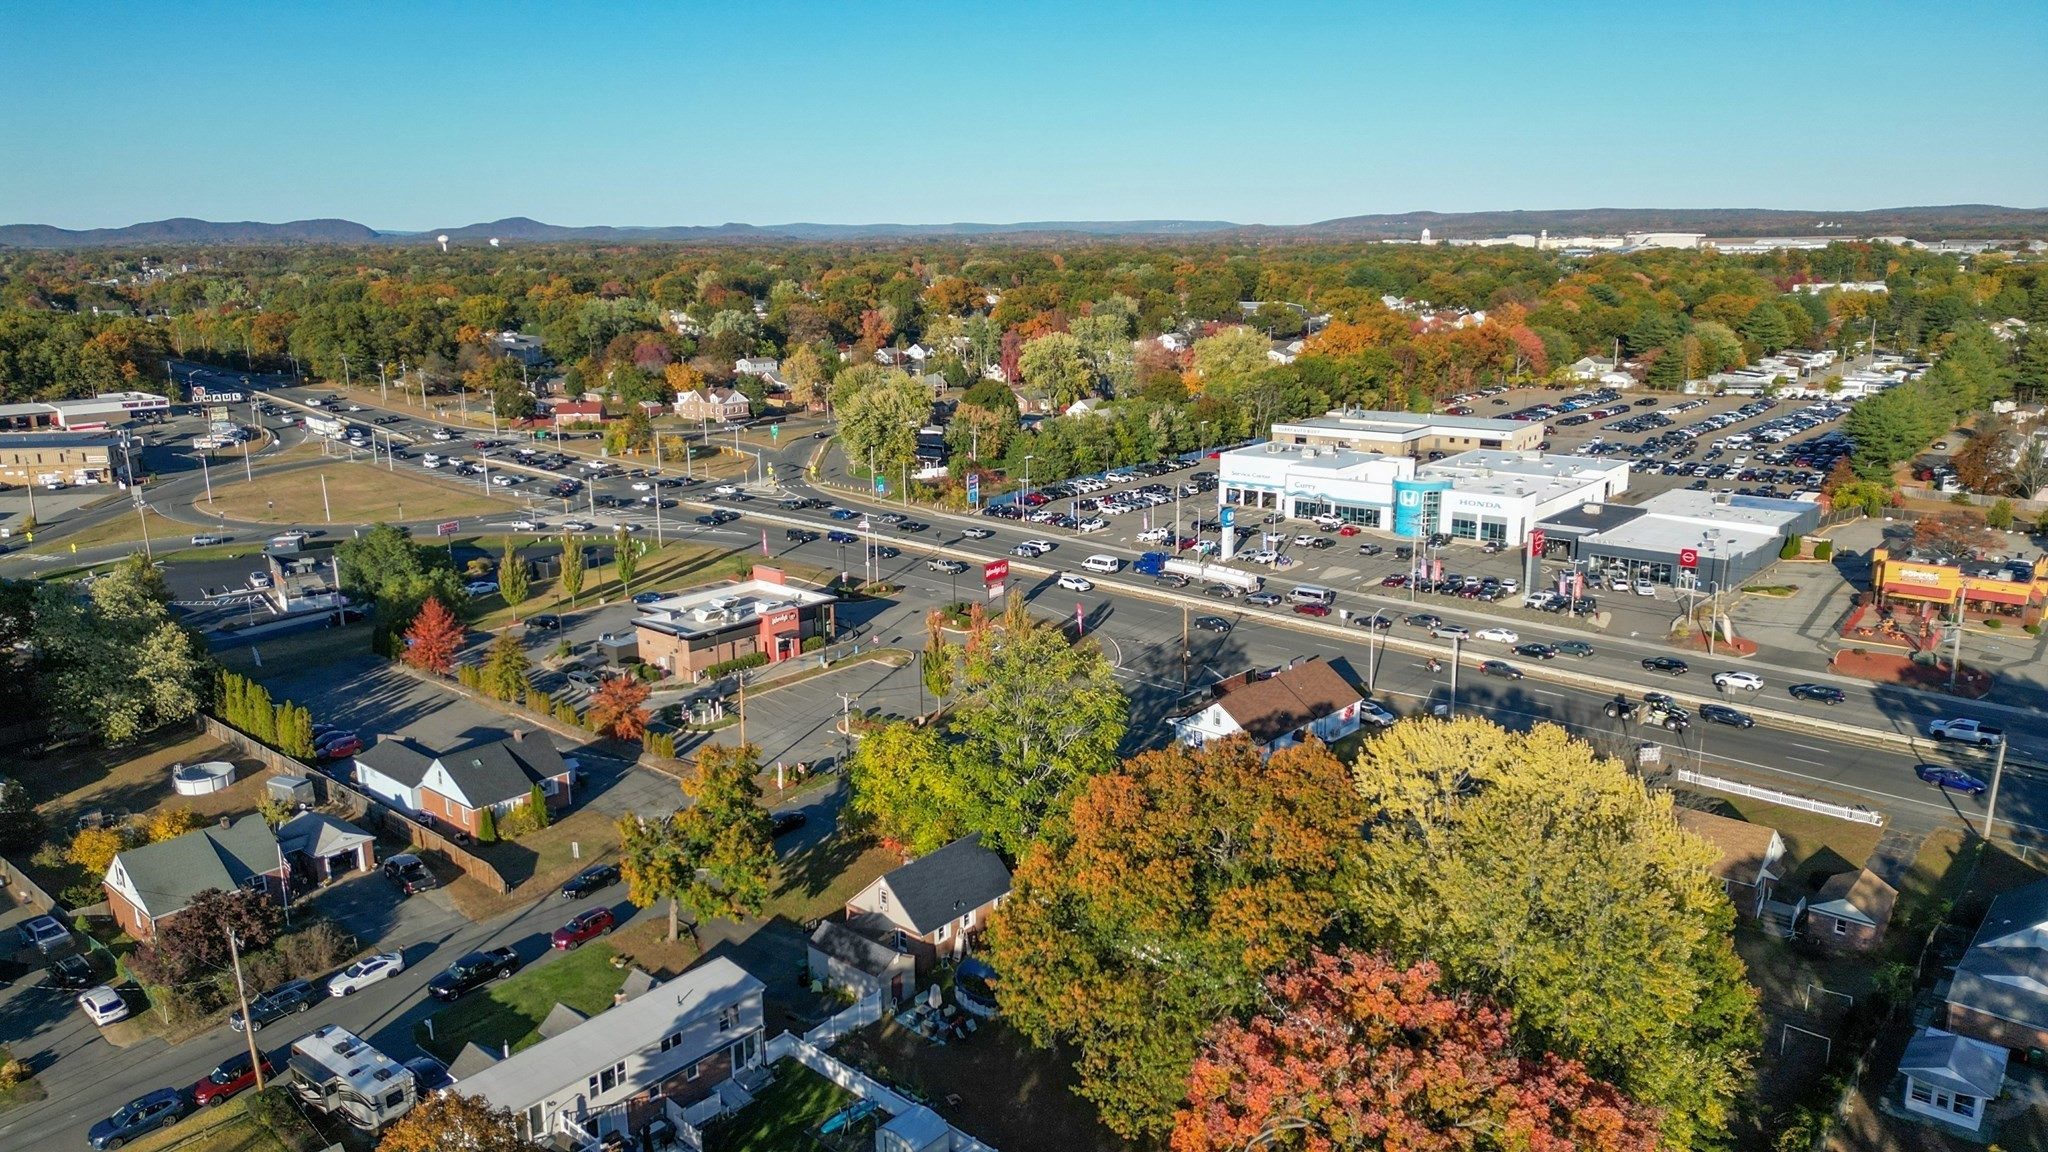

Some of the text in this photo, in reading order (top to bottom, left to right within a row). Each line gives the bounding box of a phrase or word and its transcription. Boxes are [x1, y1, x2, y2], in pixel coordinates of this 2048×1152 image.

[1294, 481, 1316, 490] Curry
[1459, 499, 1502, 509] HONDA
[1901, 569, 1940, 581] POPEYES
